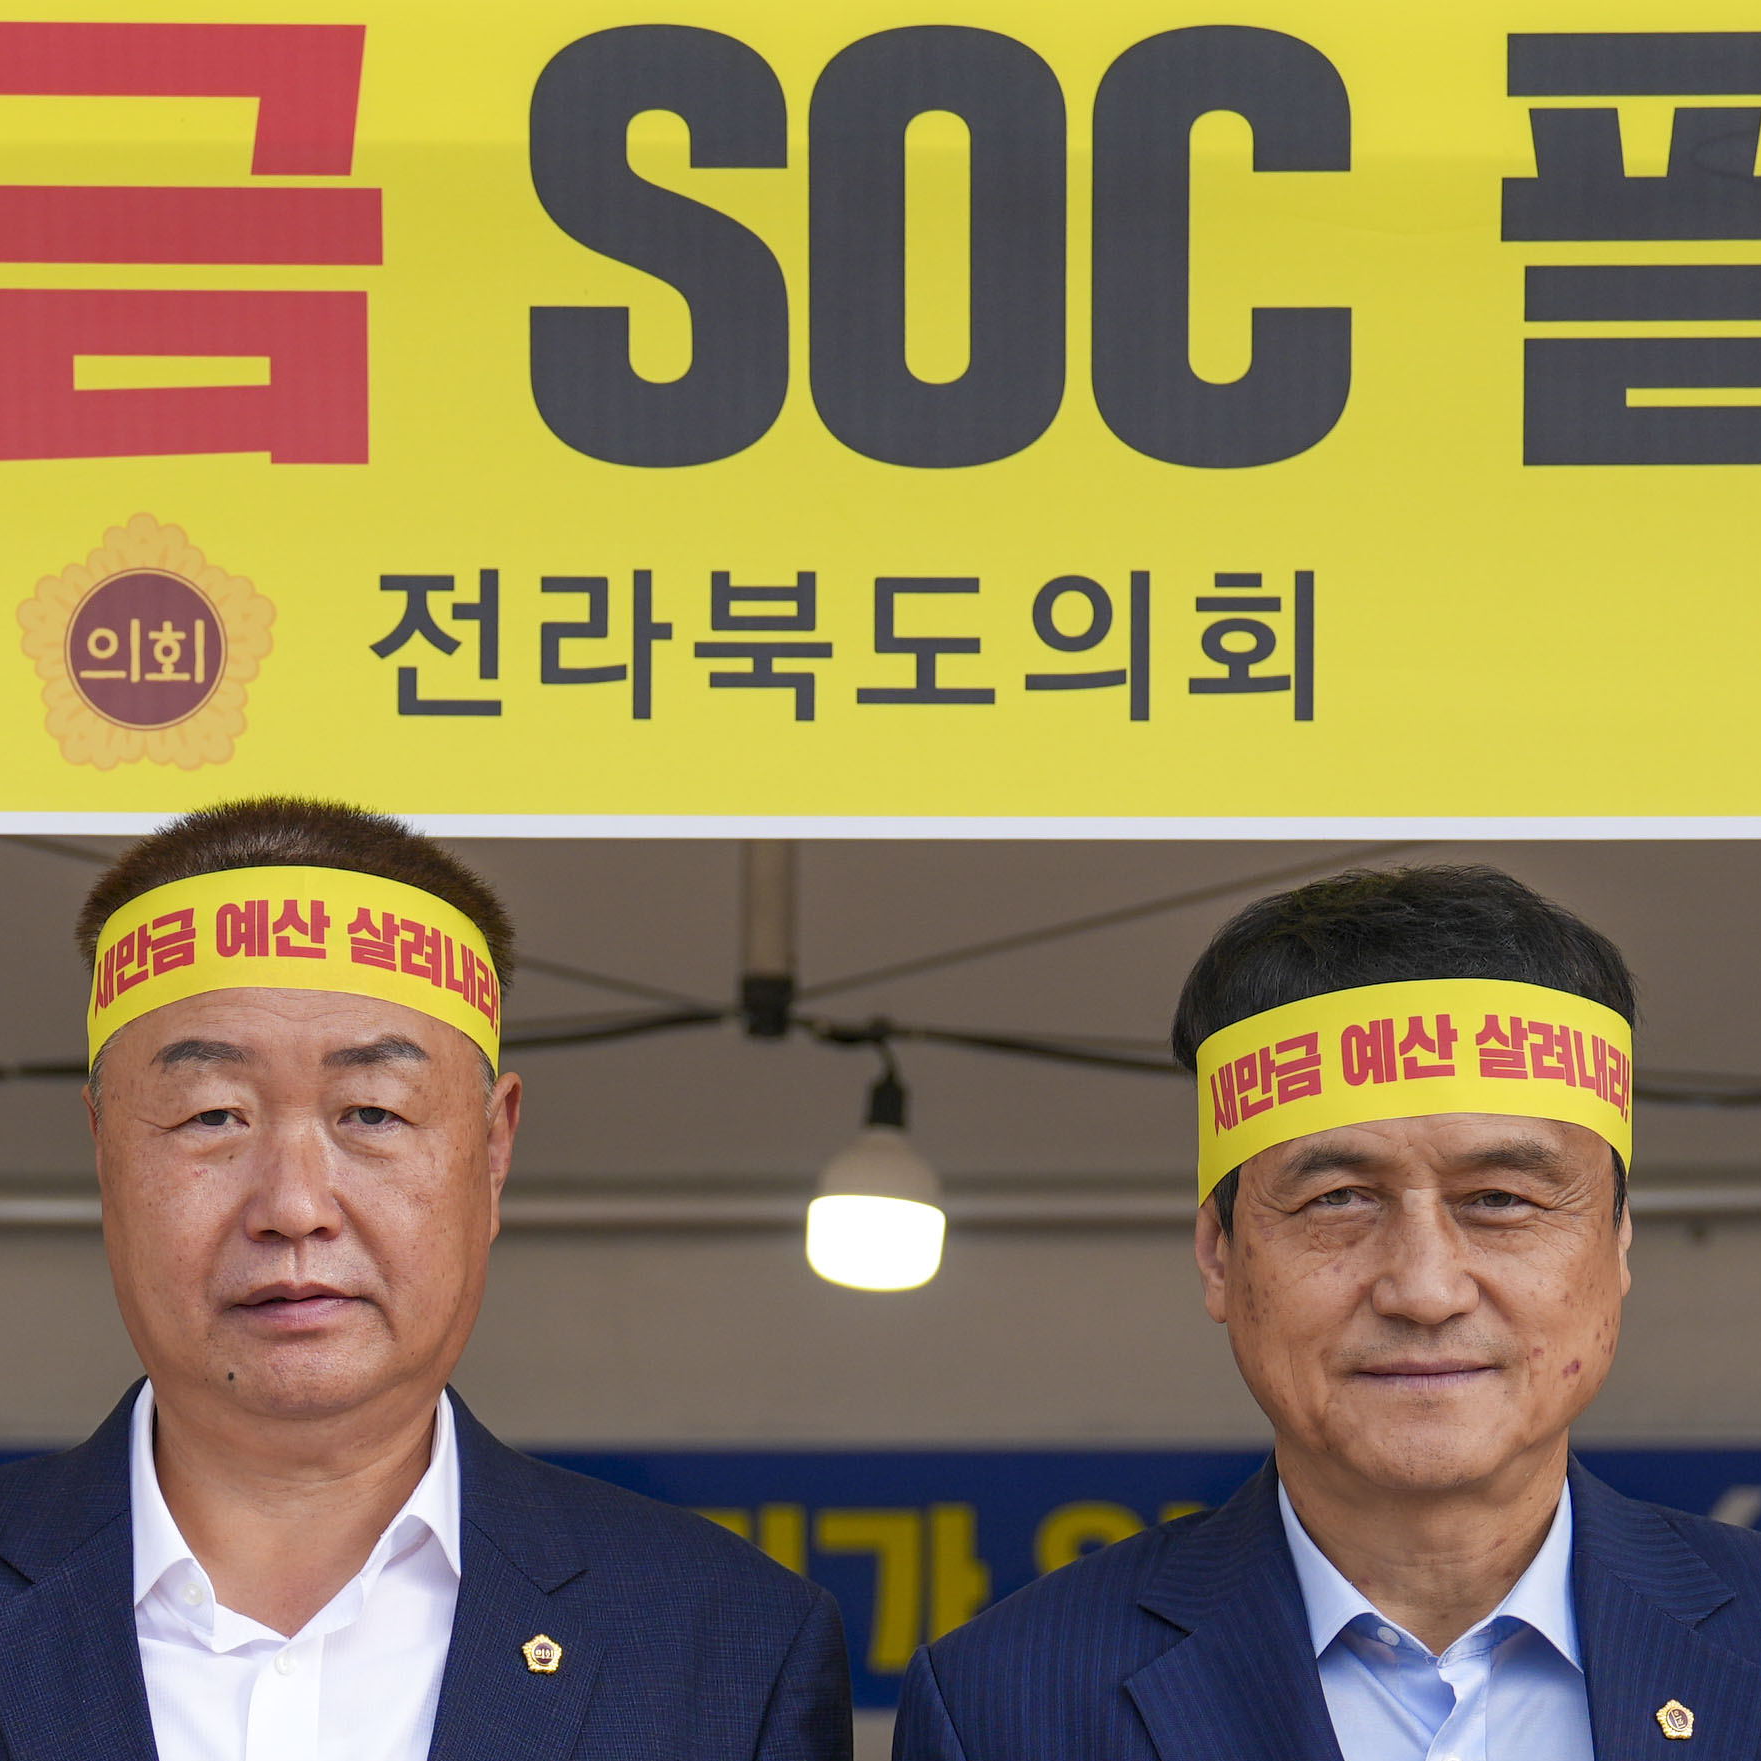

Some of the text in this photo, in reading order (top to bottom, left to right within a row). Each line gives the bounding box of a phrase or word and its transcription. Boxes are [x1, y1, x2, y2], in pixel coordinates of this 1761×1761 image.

[528, 22, 1352, 469] SOC
[79, 618, 205, 683] 의회
[369, 568, 1314, 721] 전라북도의회
[95, 899, 501, 1037] 새만금 예산 살려내라!
[1210, 1014, 1630, 1137] 새만금 예산 살려내라!
